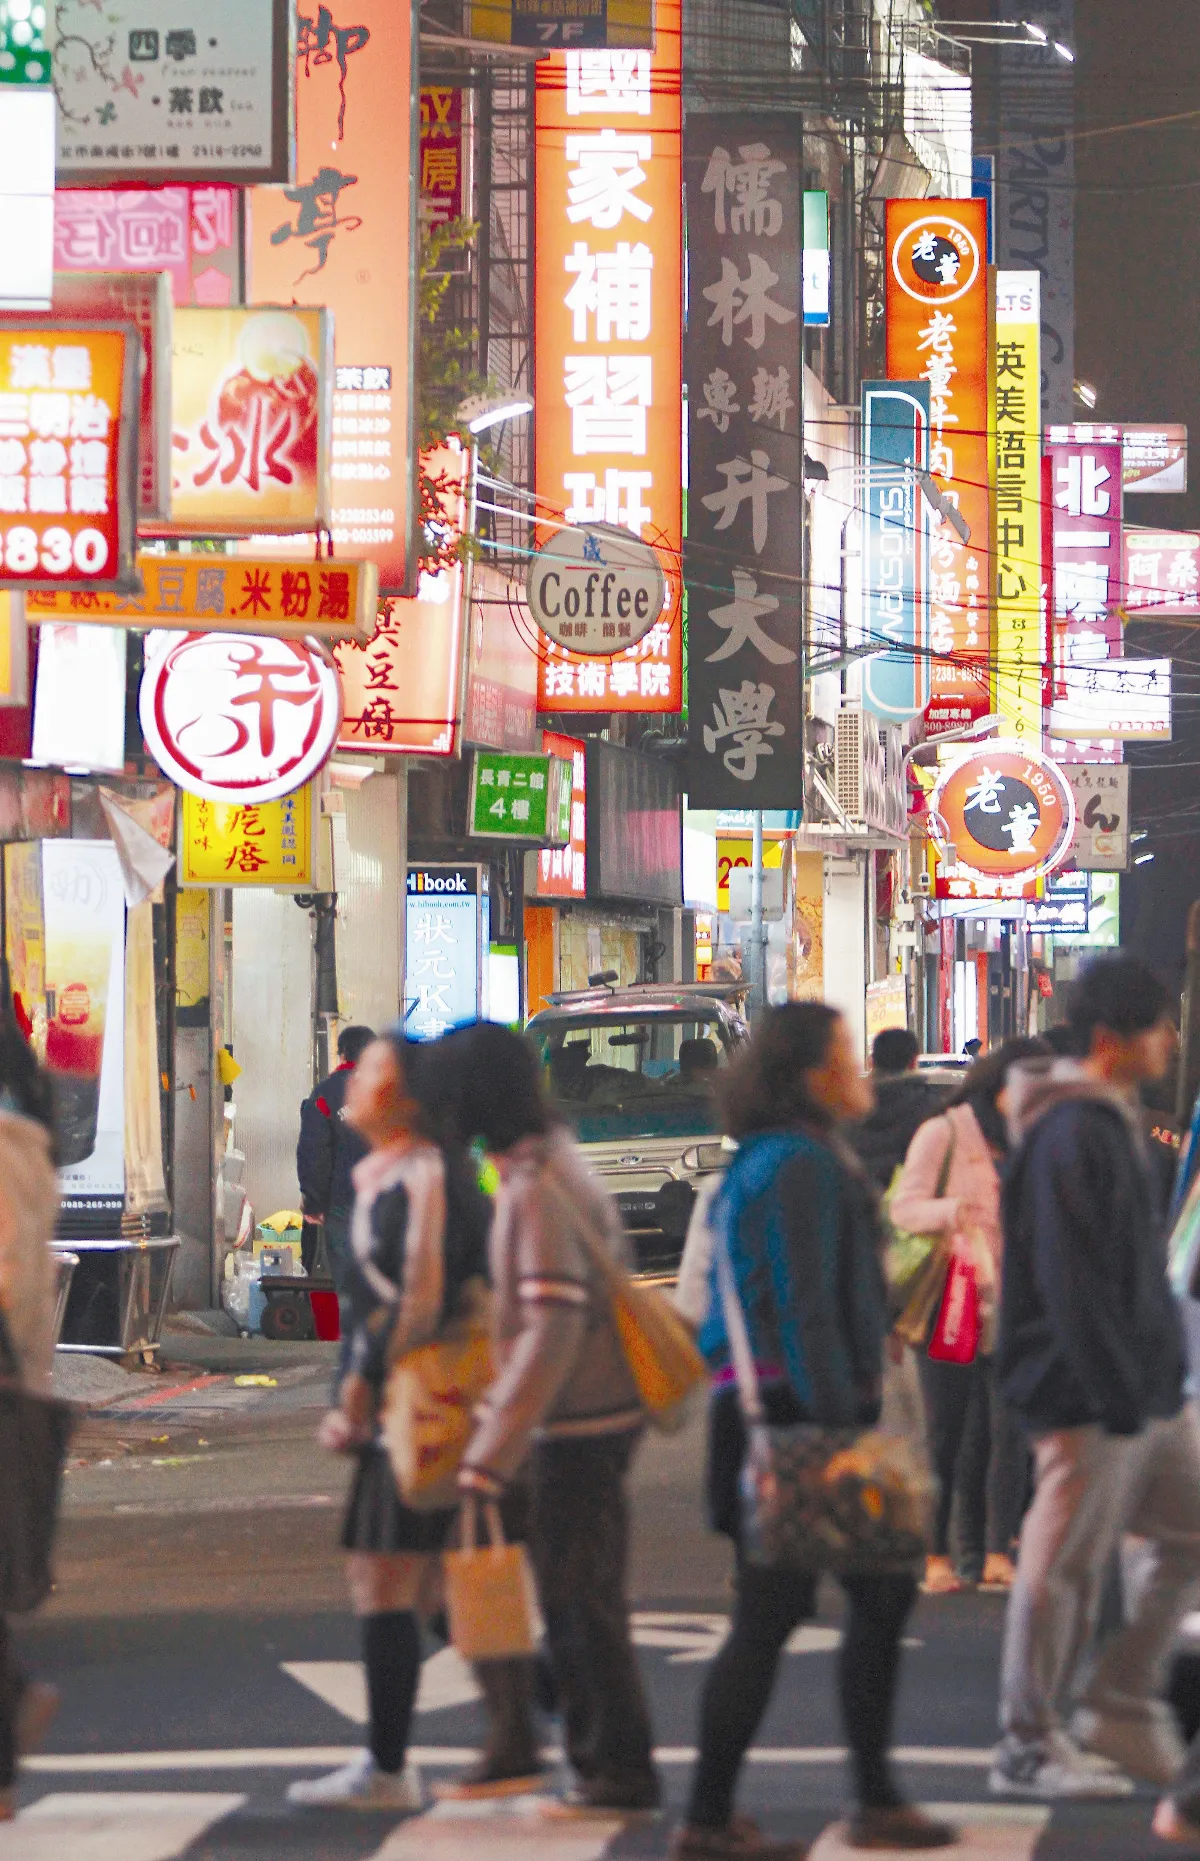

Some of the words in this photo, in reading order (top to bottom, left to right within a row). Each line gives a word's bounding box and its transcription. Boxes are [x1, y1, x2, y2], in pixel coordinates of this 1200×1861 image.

[564, 51, 654, 537] 國家補習班
[912, 230, 961, 286] 老董
[172, 397, 295, 492] 冰
[996, 341, 1026, 601] 英美語言中心
[0, 526, 108, 574] 830
[877, 487, 904, 642] watsons
[539, 572, 649, 617] Coffee
[545, 661, 671, 696] 技術學院
[963, 766, 1042, 856] 老董
[1021, 764, 1057, 807] 1950
